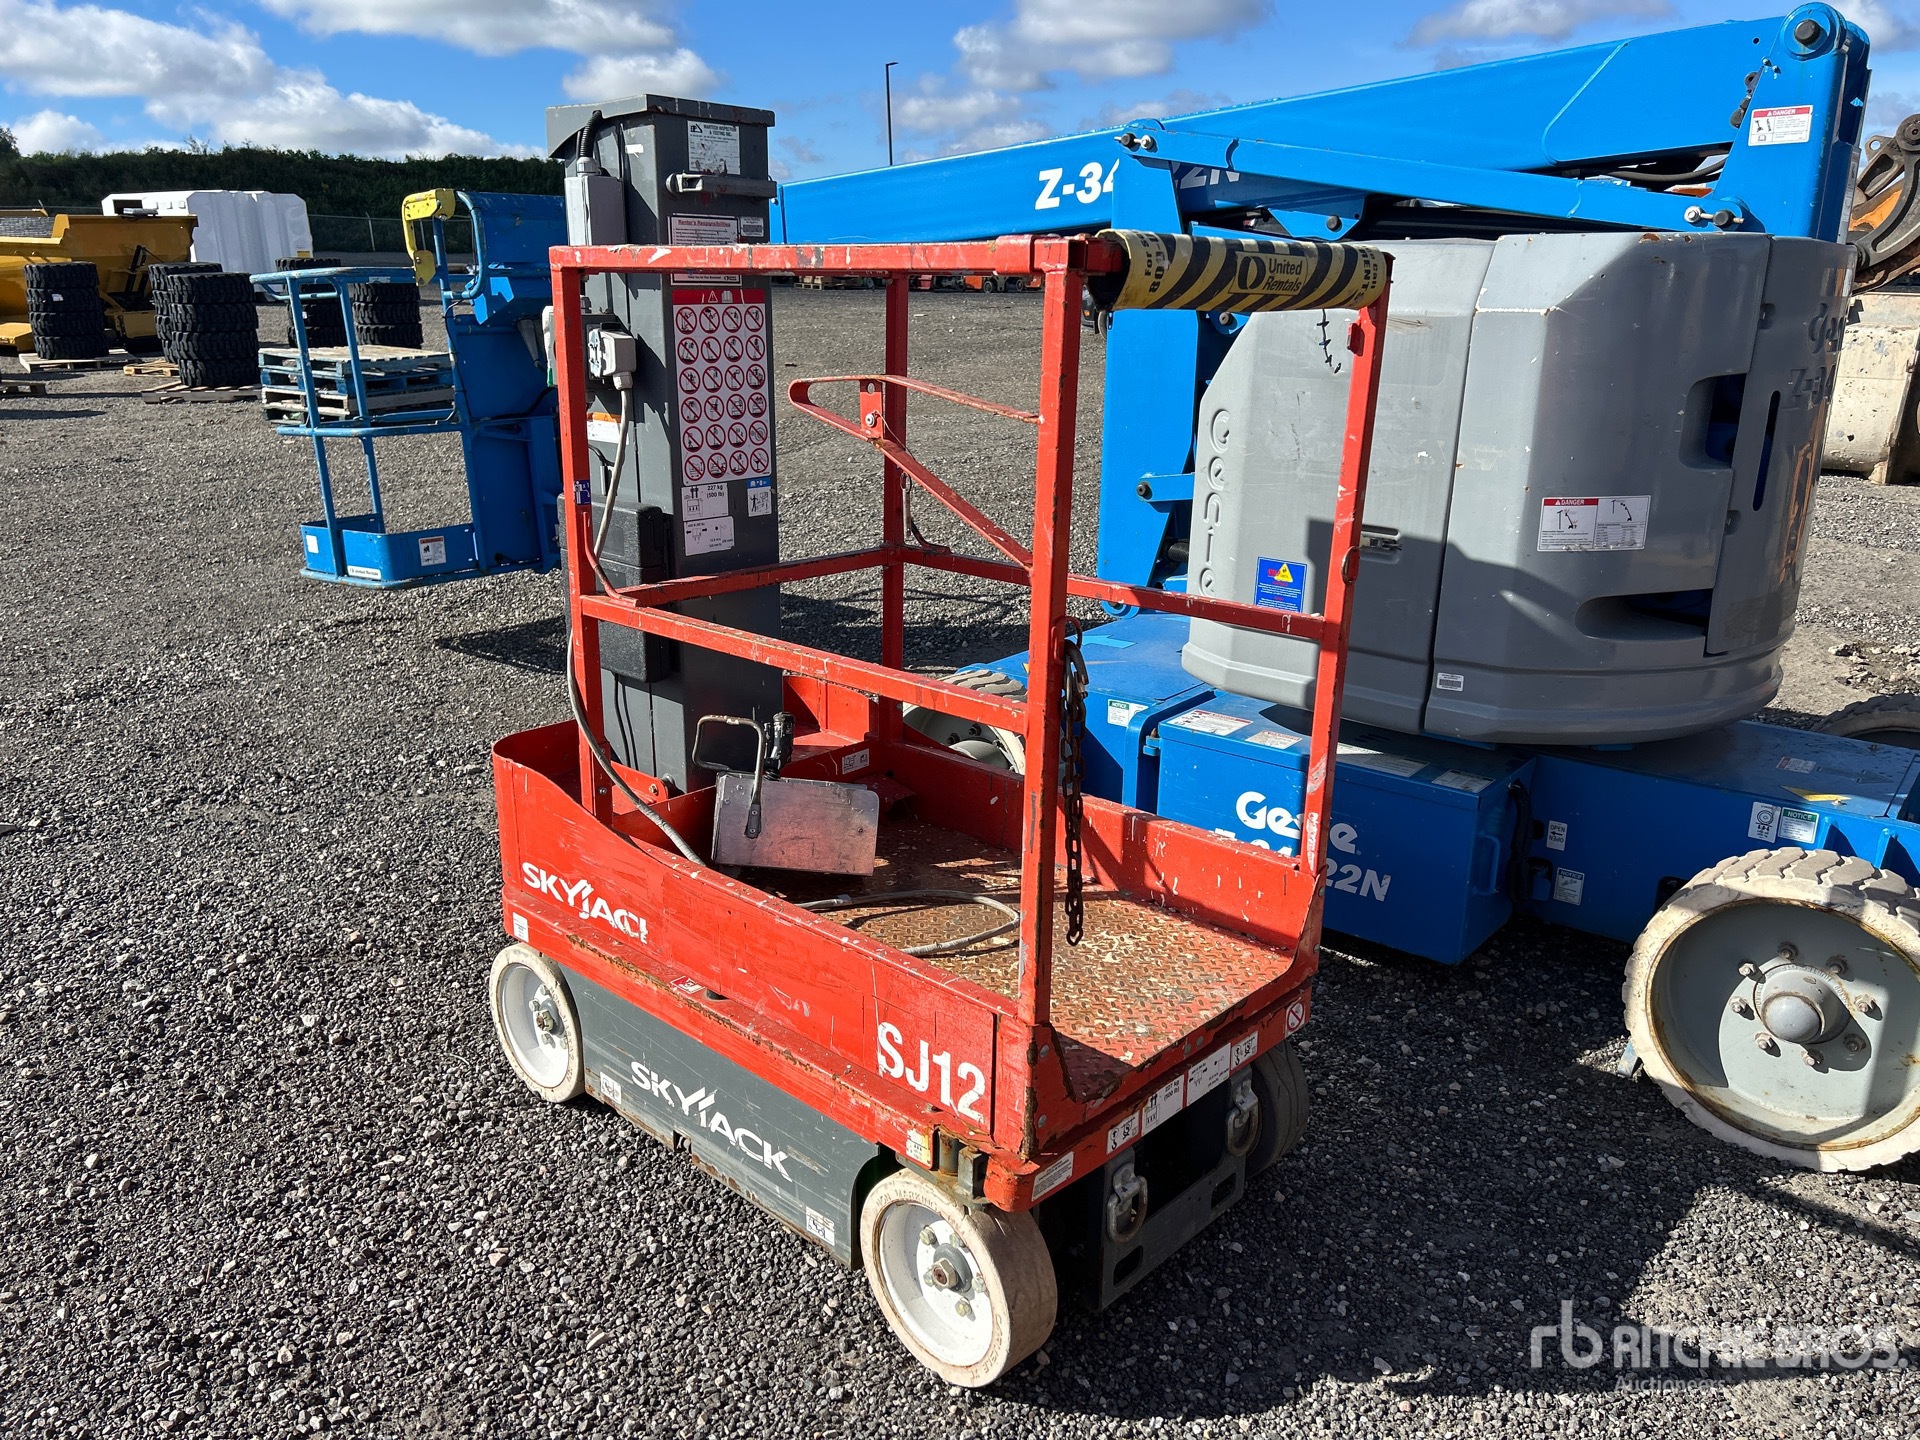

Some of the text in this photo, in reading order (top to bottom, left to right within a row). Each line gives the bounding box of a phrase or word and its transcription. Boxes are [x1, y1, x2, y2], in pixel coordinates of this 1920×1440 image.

[1144, 252, 1153, 276] For
[1268, 258, 1303, 275] United
[1261, 276, 1302, 292] Rentals
[1199, 408, 1231, 598] Genie
[1787, 810, 1813, 820] NOTICE
[1550, 824, 1566, 833] OPEN
[1561, 870, 1582, 880] NOTICE
[877, 1021, 986, 1124] SJ12
[1164, 1084, 1173, 1093] 227
[630, 1061, 793, 1183] SKYJACK
[894, 1189, 939, 1211] MARKING
